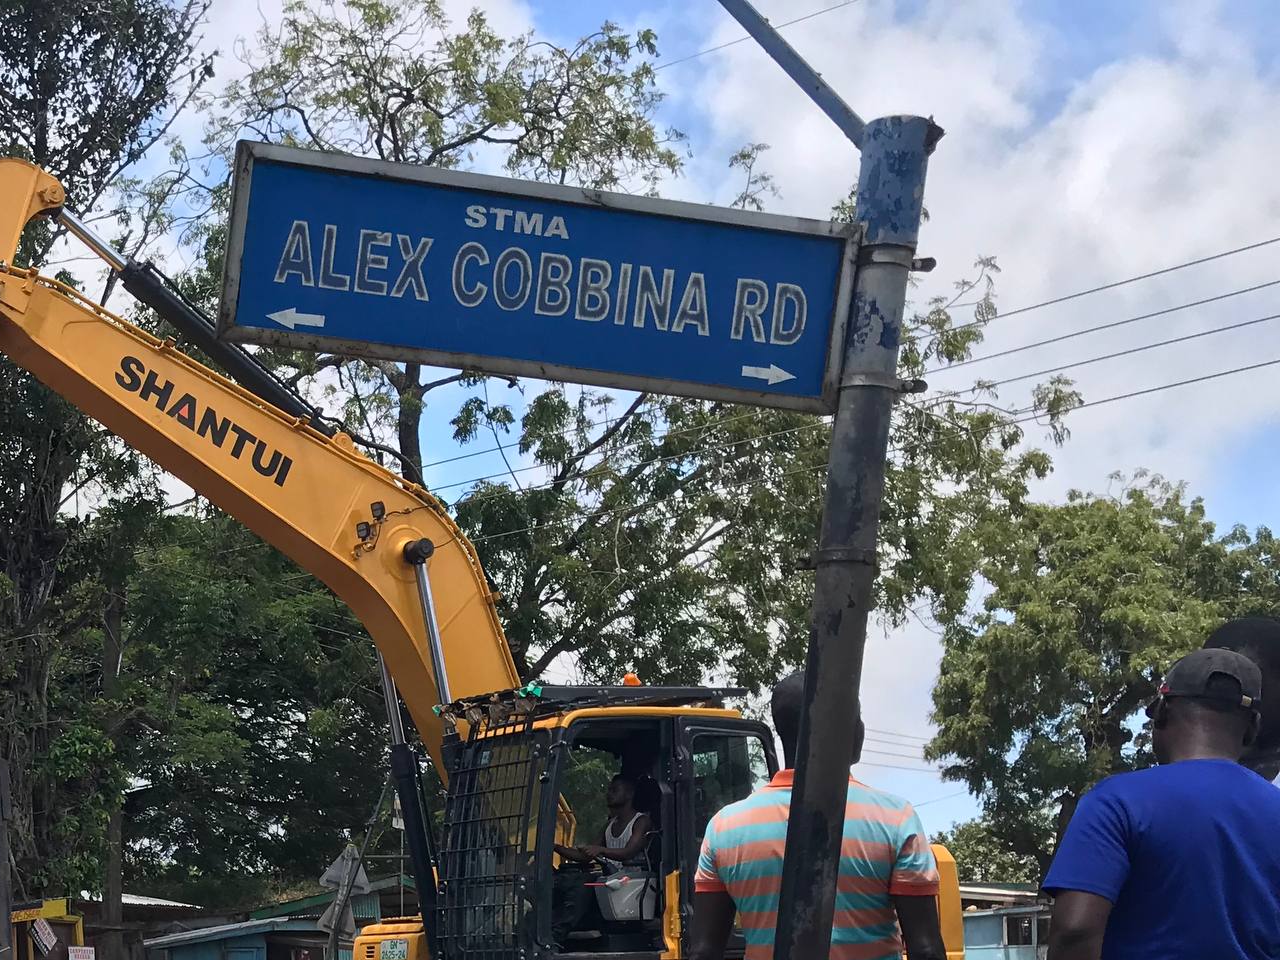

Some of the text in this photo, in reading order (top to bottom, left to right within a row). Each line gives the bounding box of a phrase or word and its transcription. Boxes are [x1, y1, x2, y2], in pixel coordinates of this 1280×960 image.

[273, 220, 808, 345] ALEX COBBINA RD
[464, 205, 570, 240] STMA
[115, 356, 293, 487] SHANTUI
